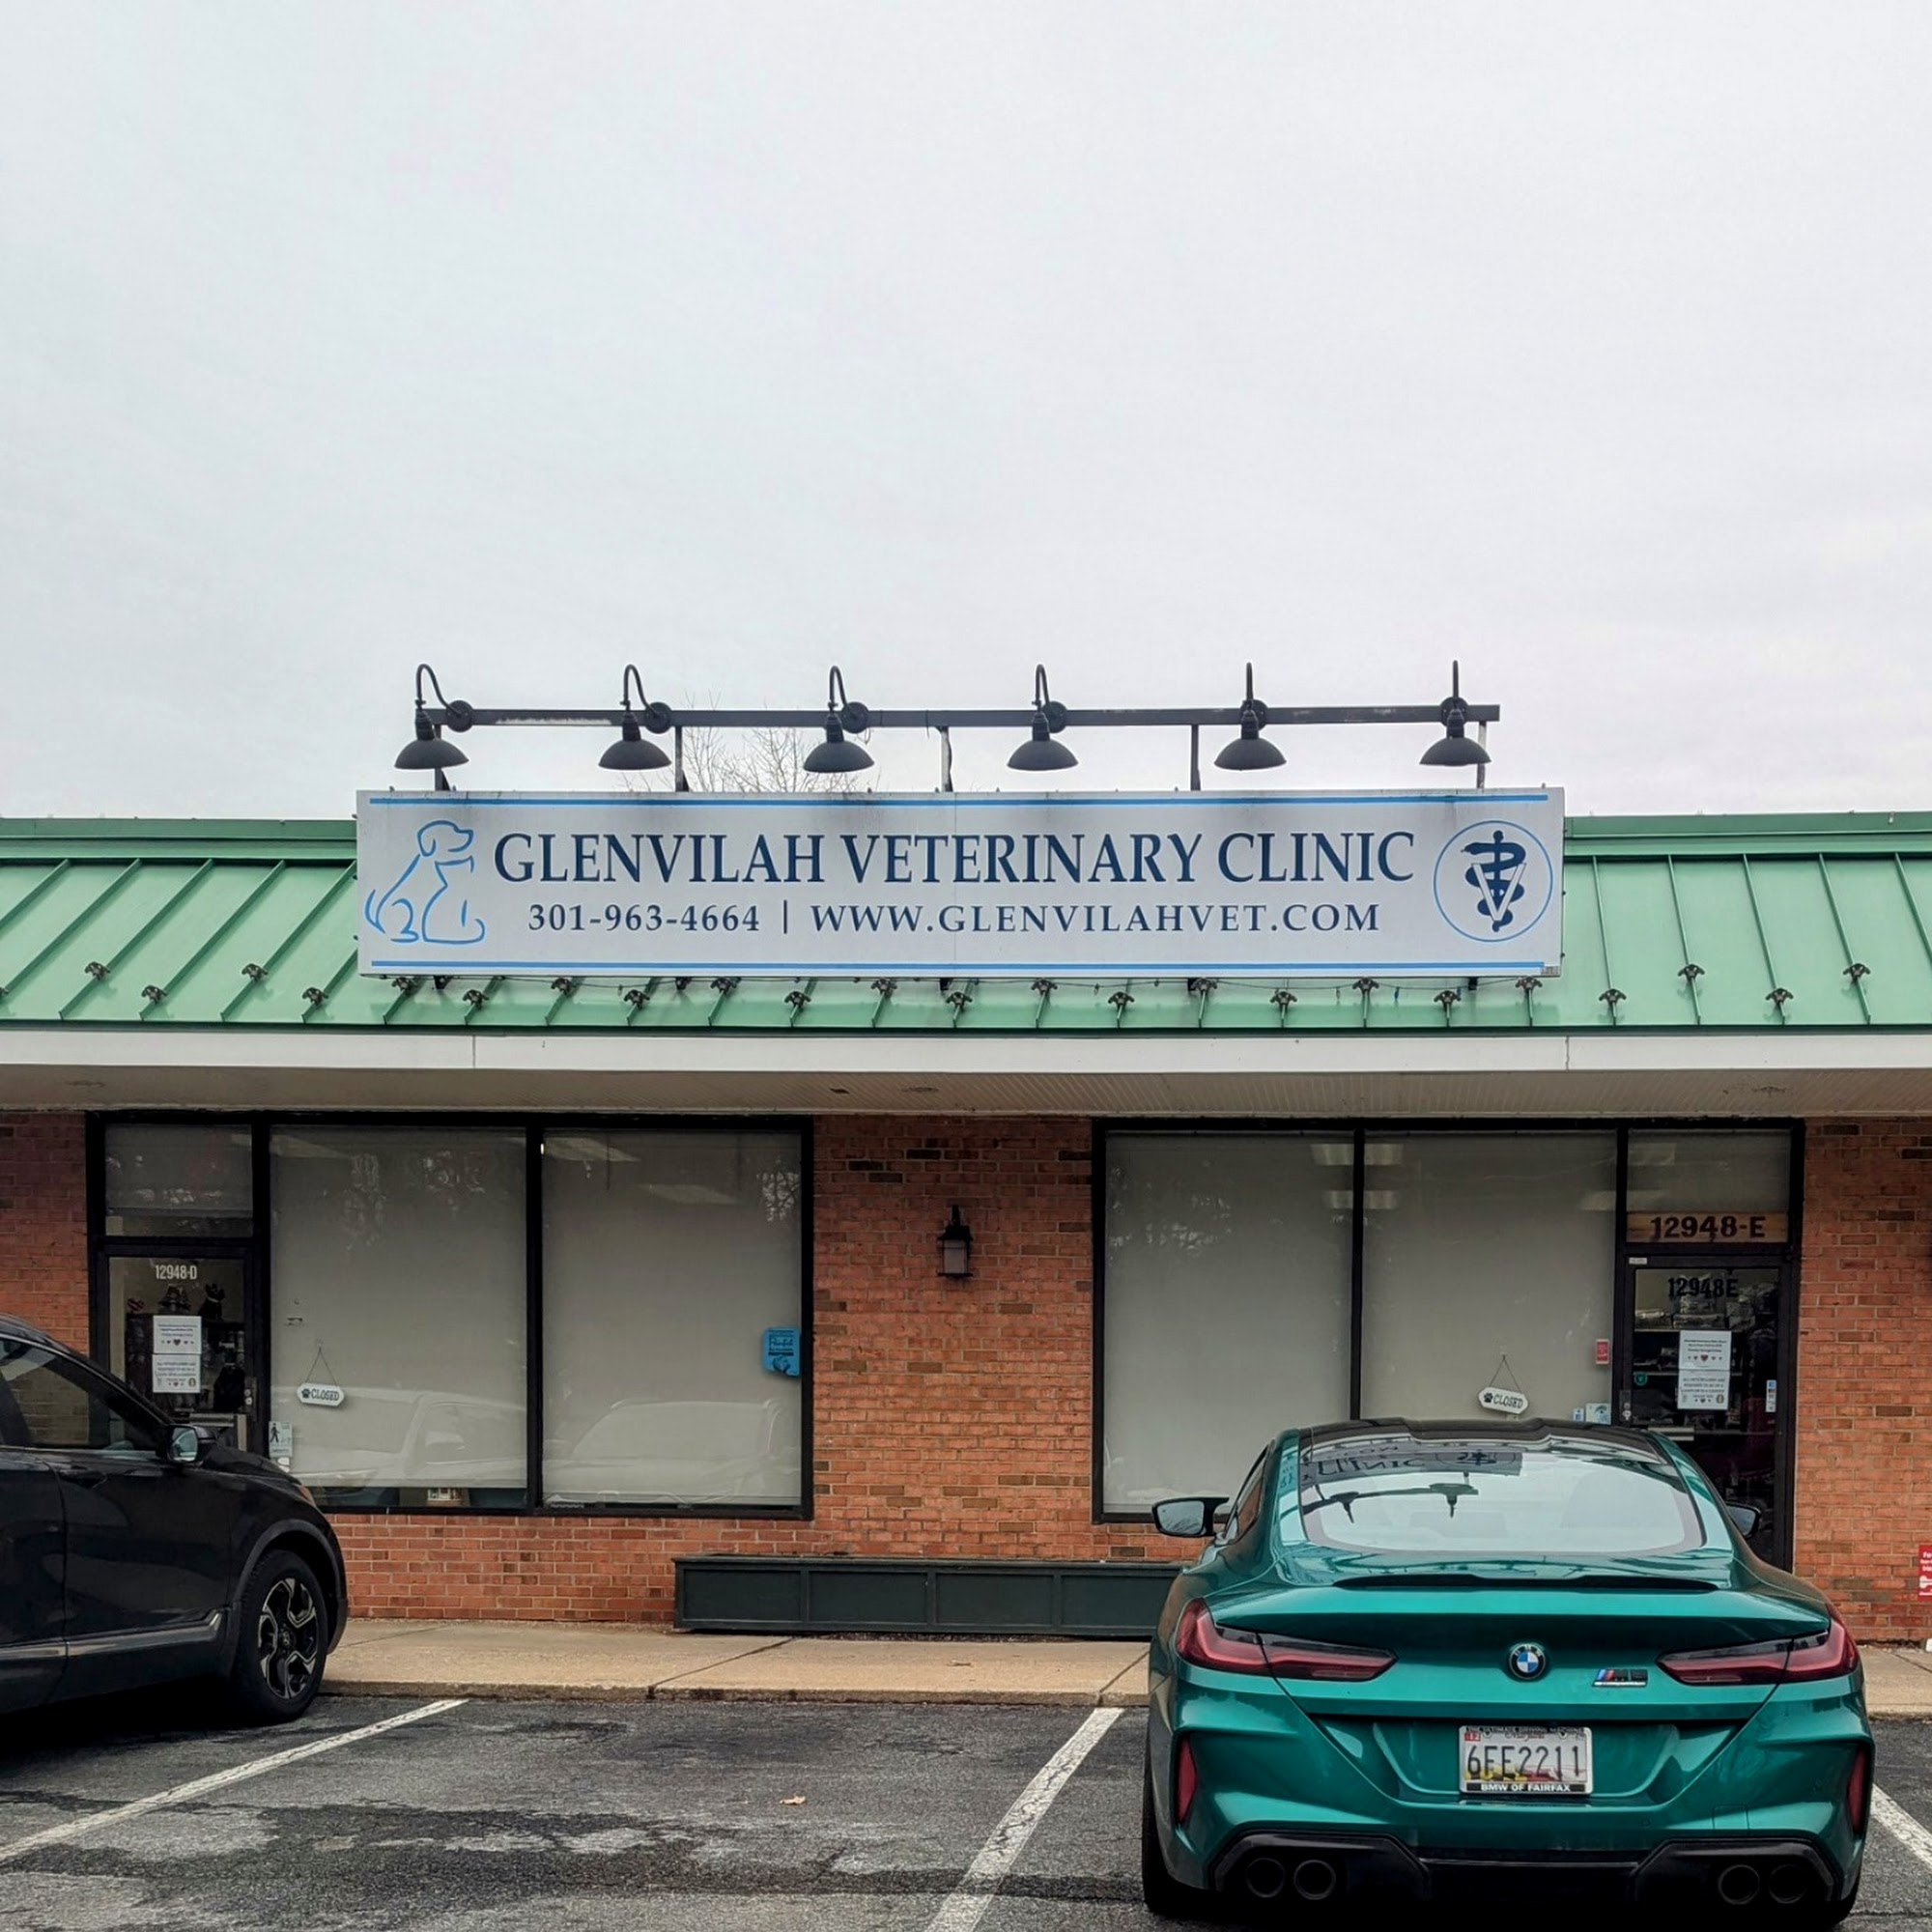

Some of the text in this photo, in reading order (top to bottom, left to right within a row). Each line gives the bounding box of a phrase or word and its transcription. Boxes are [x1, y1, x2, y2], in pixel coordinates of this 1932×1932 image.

[495, 831, 1413, 884] GLENVILAH VETERINARY CLINIC
[528, 903, 1379, 932] 301-963-4664 WWW.GLENVILAHVET.COM
[1650, 1215, 1767, 1240] 12948-E
[156, 1264, 198, 1280] 12948-D
[1667, 1276, 1739, 1299] 12948E
[310, 1388, 340, 1402] CLOSED
[1492, 1393, 1523, 1409] CLOSED
[1481, 1783, 1571, 1792] BMW OF FAIRFAX
